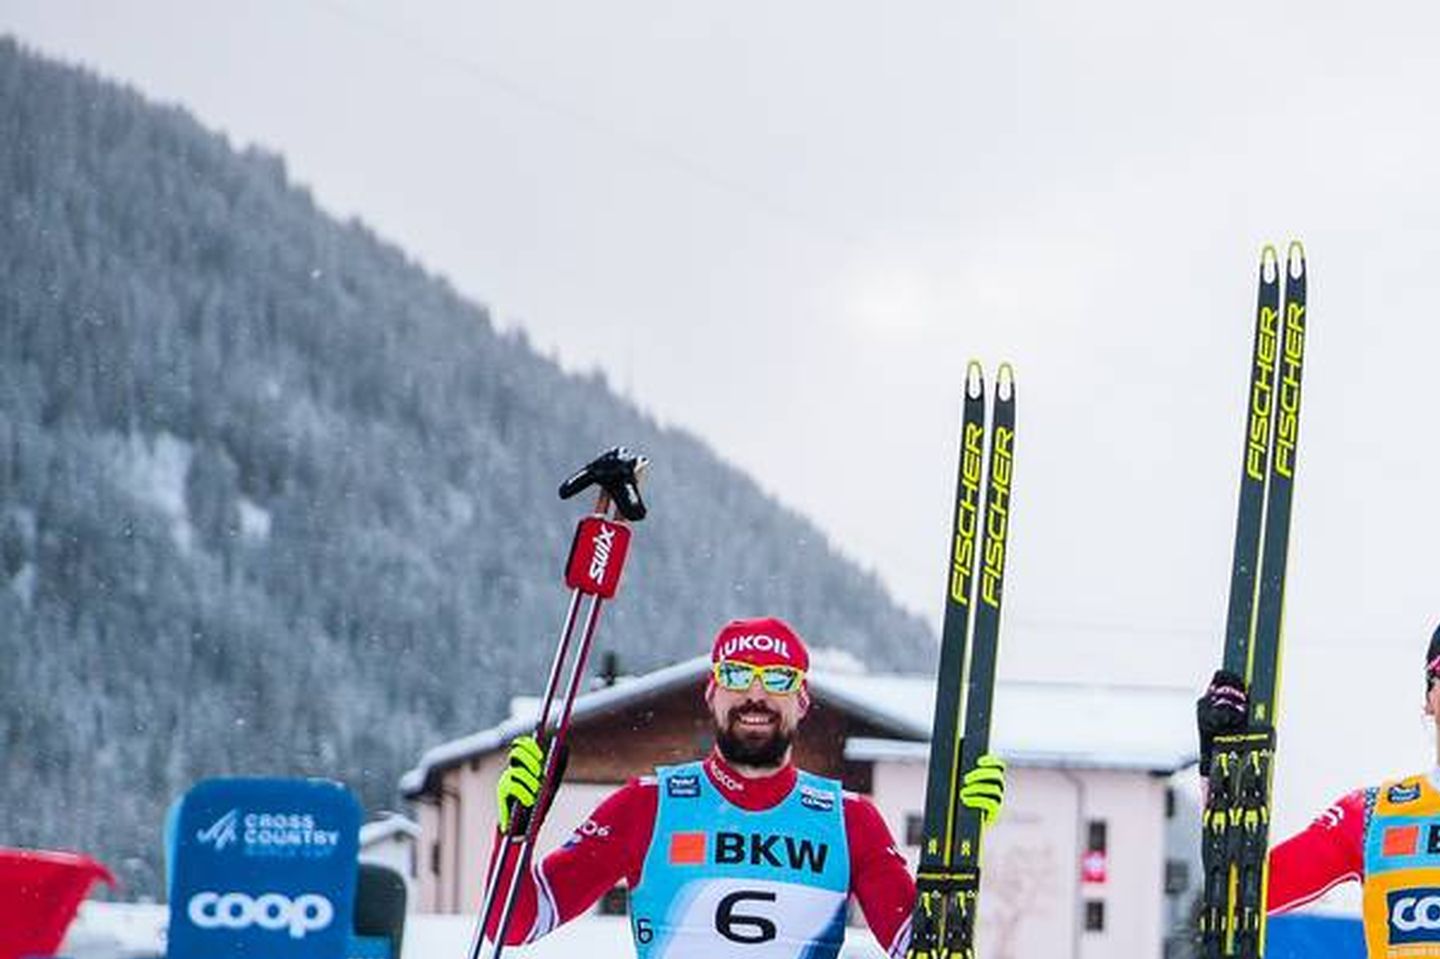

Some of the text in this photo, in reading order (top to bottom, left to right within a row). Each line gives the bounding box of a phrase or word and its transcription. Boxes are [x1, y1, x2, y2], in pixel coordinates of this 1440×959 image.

[1246, 305, 1278, 481] FISCHER
[1274, 302, 1304, 478] FISCHER
[951, 422, 983, 606] FISCHER
[982, 426, 1014, 608] FISCHER
[243, 829, 340, 846] COUNTRY
[244, 813, 315, 829] CROSS
[714, 832, 828, 874] BKW
[188, 892, 334, 938] coop
[714, 890, 777, 944] 6
